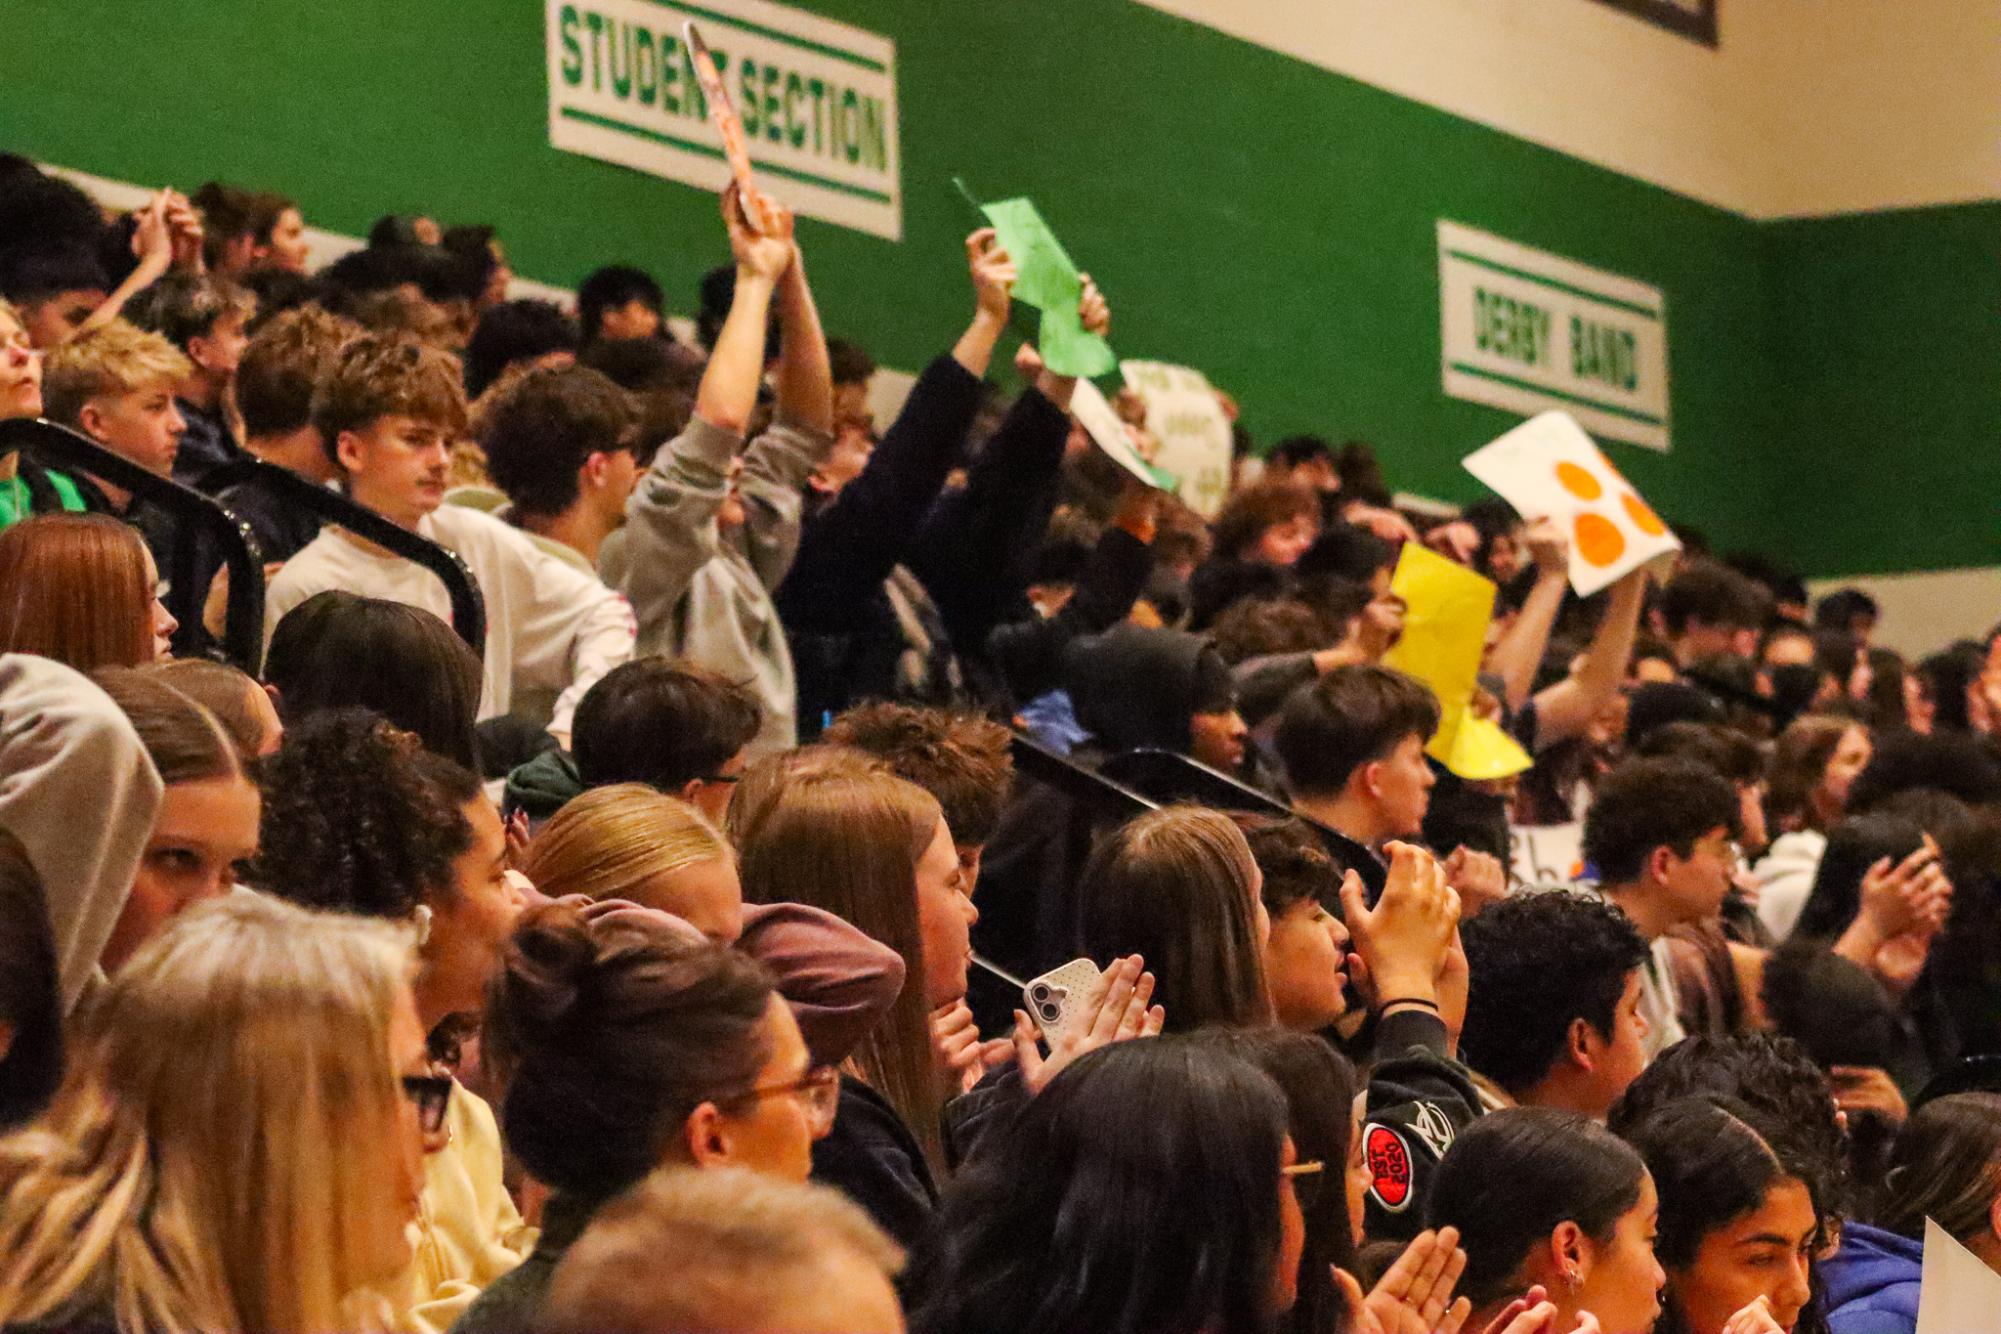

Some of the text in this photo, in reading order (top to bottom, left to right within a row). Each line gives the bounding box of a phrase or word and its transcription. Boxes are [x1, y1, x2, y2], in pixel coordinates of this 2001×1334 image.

[741, 58, 887, 173] SECTION
[1474, 285, 1637, 392] DERBY BAND
[1373, 1150, 1388, 1180] EST
[1386, 1142, 1406, 1184] 2020
